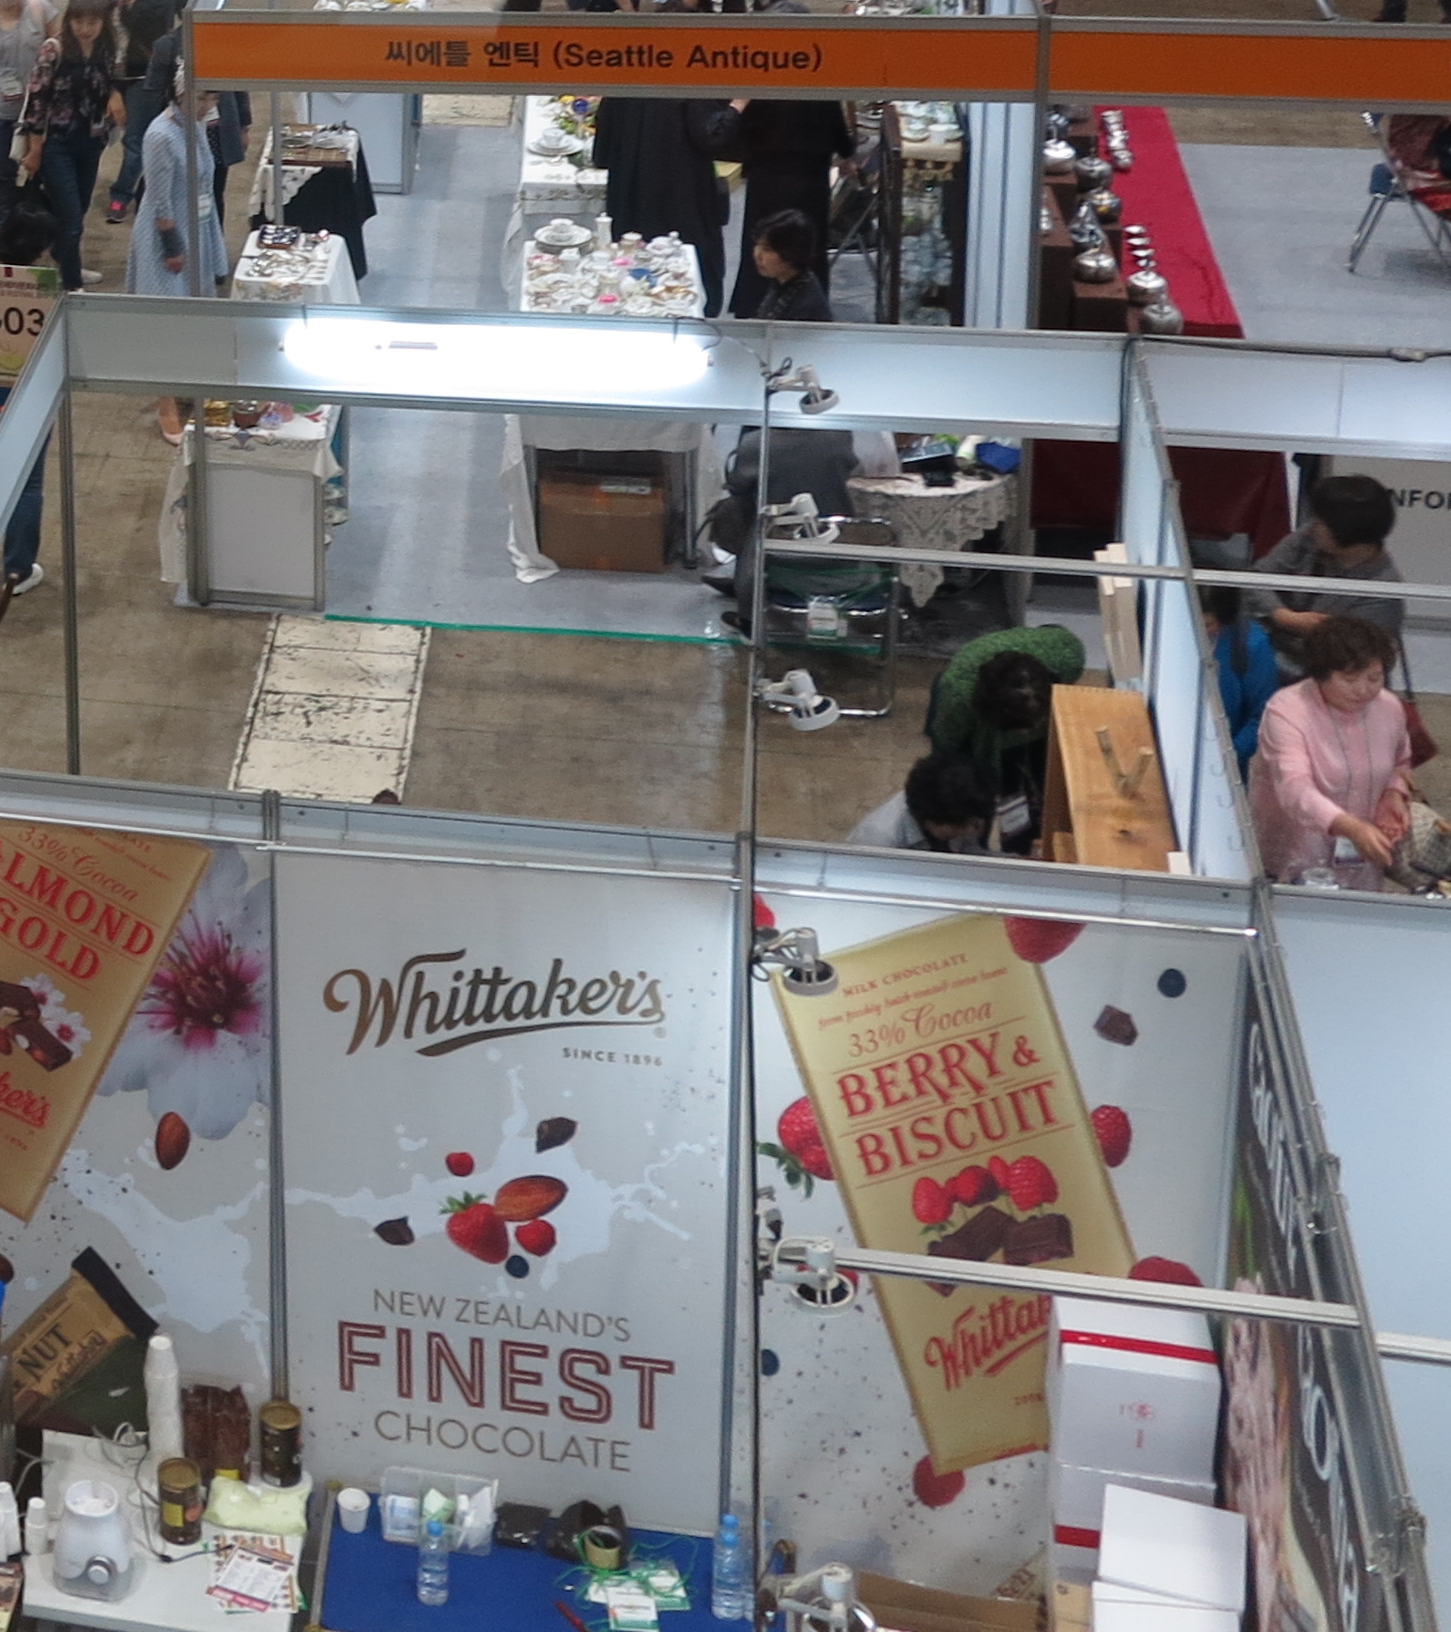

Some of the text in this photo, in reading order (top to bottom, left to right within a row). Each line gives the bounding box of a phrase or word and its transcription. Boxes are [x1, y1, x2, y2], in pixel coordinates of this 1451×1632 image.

[484, 40, 540, 67] 엔틱
[553, 41, 673, 71] (Seattle
[687, 42, 823, 74] Antique)
[1392, 489, 1451, 510] NFO
[17, 825, 70, 865] 33%
[71, 844, 140, 904] Cocoa
[322, 947, 667, 1057] Whittaker's
[847, 998, 994, 1059] 33% Cocoa
[561, 1046, 663, 1067] SINCE 1896
[835, 1030, 1043, 1121] BERRY &
[854, 1079, 1060, 1179] BISCUIT
[372, 1288, 631, 1344] NEW ZEALAND'S
[16, 1322, 74, 1383] NUT
[337, 1321, 676, 1431] FINEST
[374, 1410, 632, 1473] CHOCOLATE
